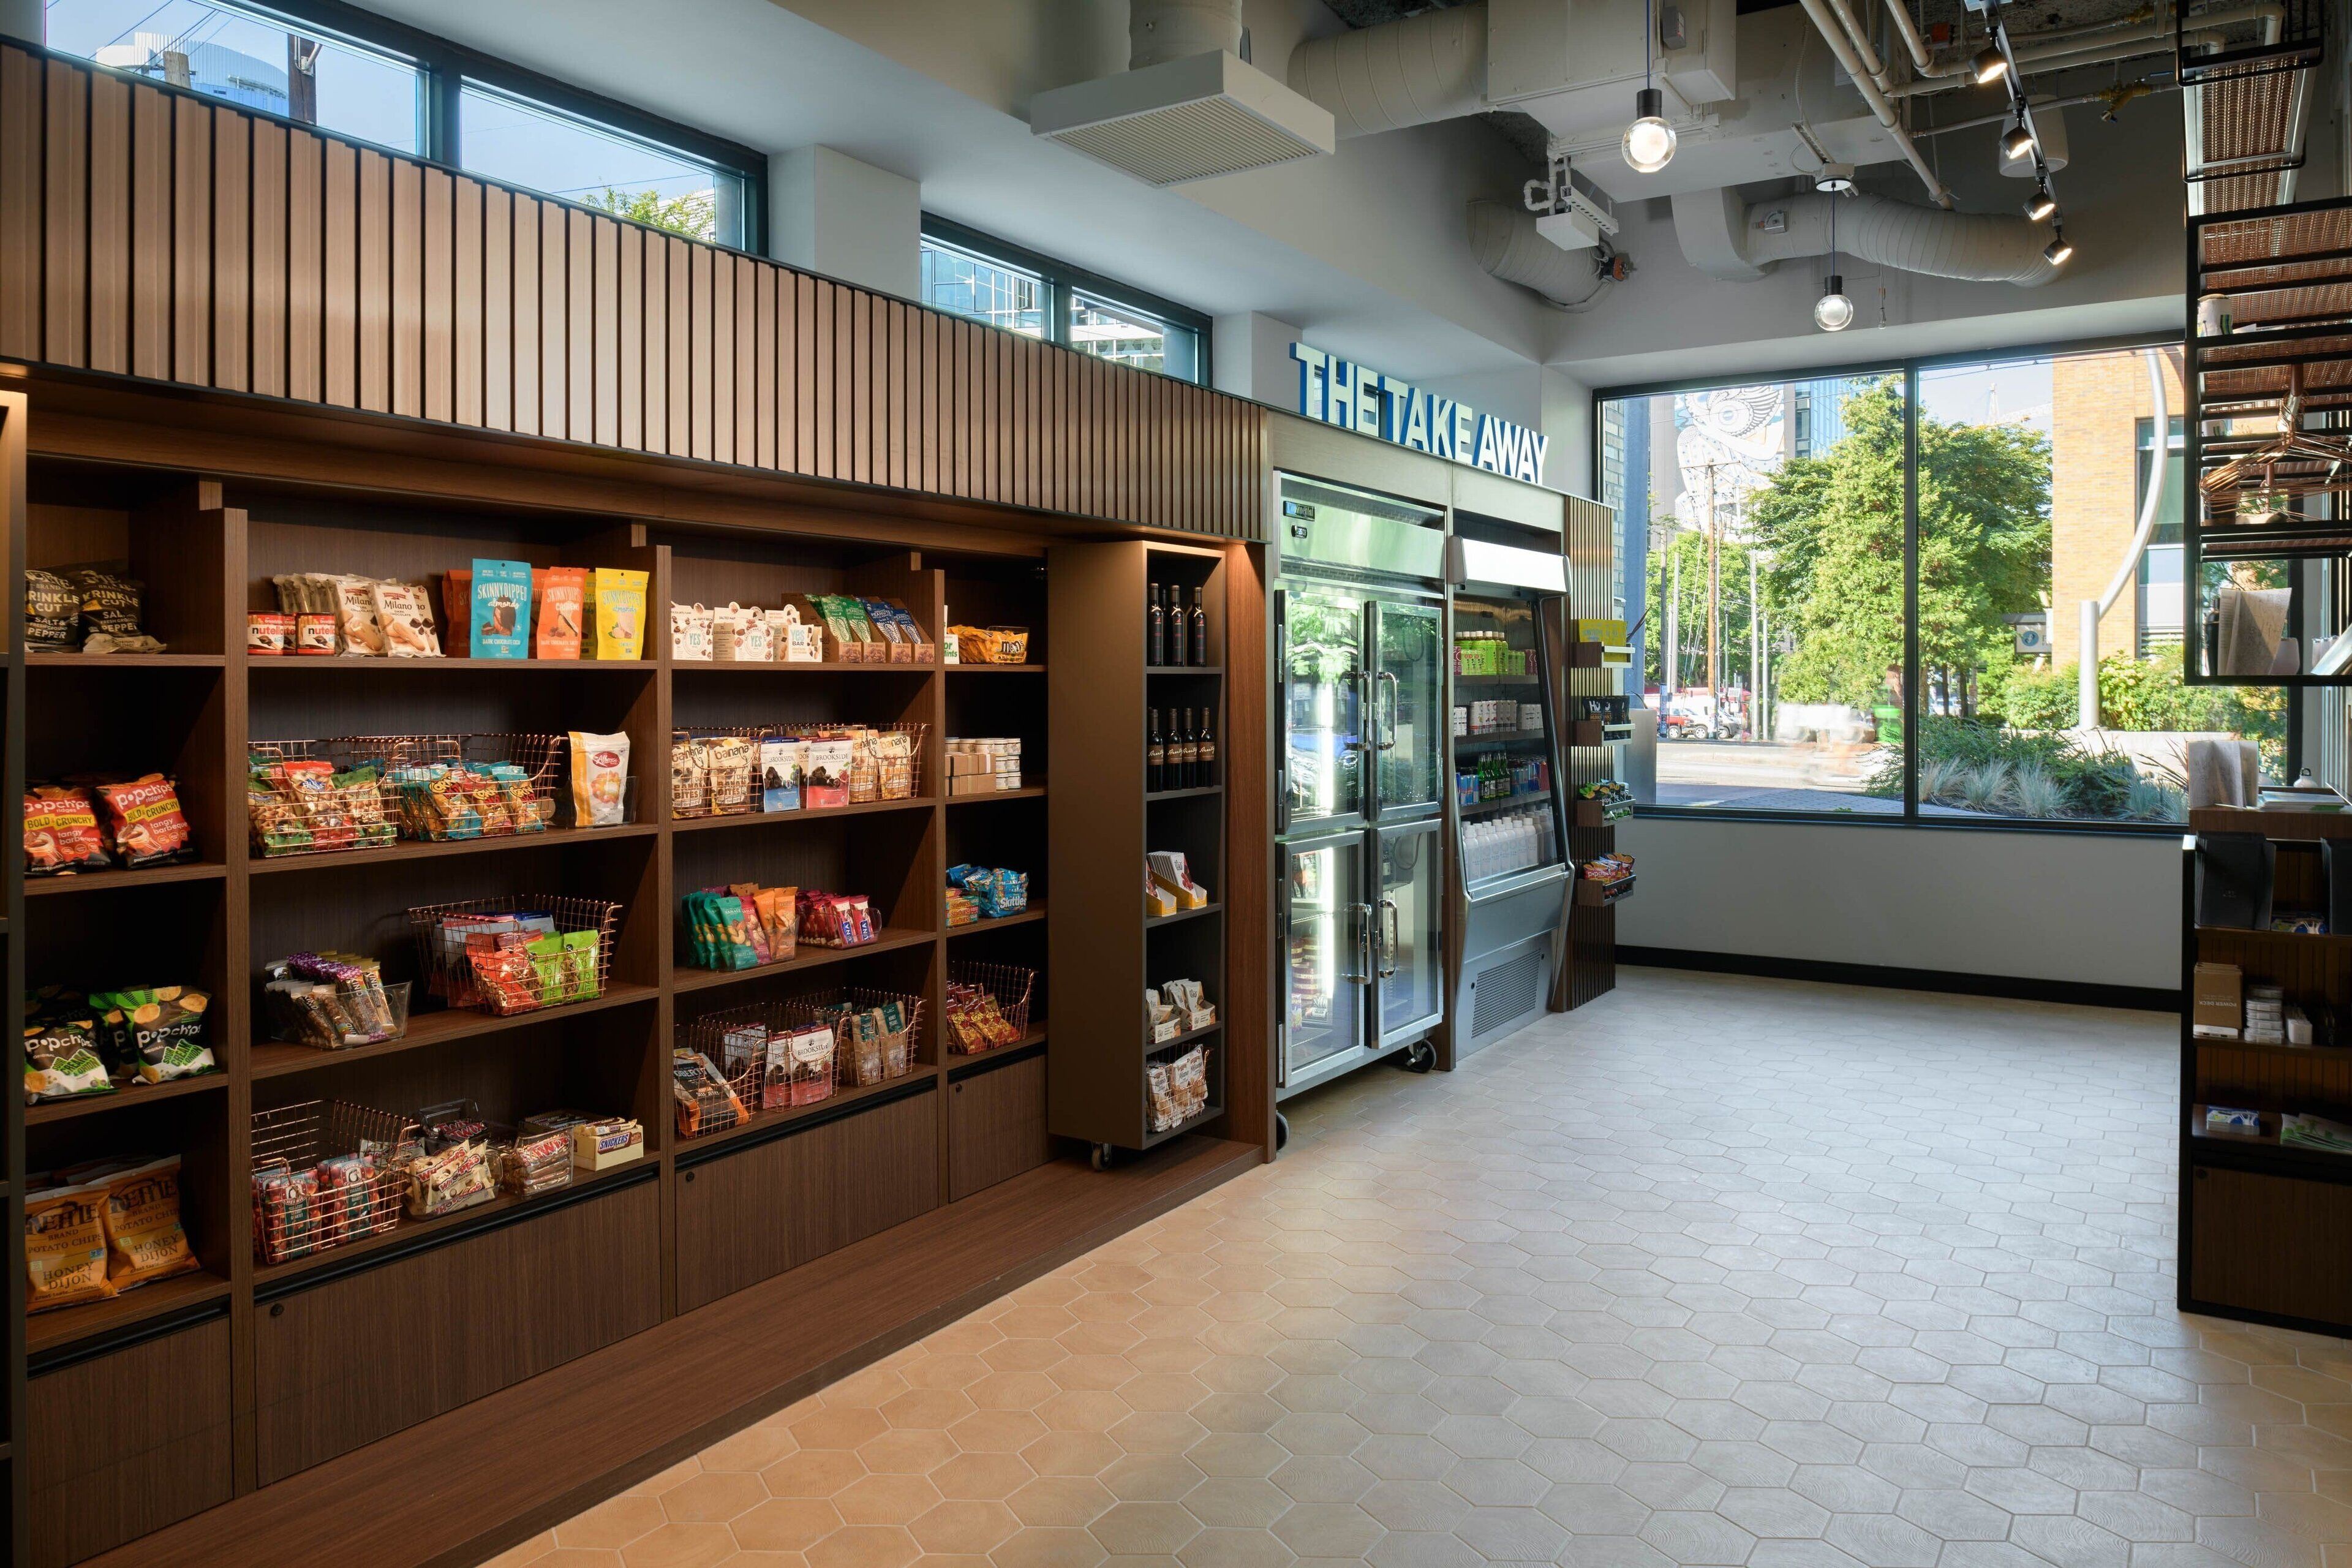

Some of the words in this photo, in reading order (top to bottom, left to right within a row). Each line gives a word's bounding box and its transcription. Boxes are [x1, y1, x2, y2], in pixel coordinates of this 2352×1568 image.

[1289, 342, 1379, 437] THE
[1378, 376, 1472, 466] TAKE
[1472, 413, 1549, 486] AWAY
[26, 590, 80, 605] RINKLE
[81, 590, 138, 607] KRINKLE
[478, 582, 527, 601] SKINNYDIPPED
[547, 586, 582, 602] SKINNYDIP
[36, 603, 61, 612] CUT
[384, 600, 412, 610] Milano
[35, 617, 58, 626] SALT
[104, 610, 126, 619] SAL
[28, 627, 66, 639] PEPPER
[690, 633, 701, 646] YES
[751, 635, 762, 647] YES
[116, 783, 172, 809] popchips
[146, 794, 164, 803] ridges
[127, 809, 142, 821] BOLD
[146, 801, 178, 818] CRUNCHY
[28, 817, 50, 829] BOLD
[56, 816, 92, 827] CRUNCHY
[150, 818, 173, 829] tangy
[153, 821, 187, 834] barbeque
[58, 829, 83, 839] tangy
[59, 836, 98, 845] barbeque
[1000, 896, 1027, 908] Skittles
[350, 977, 363, 997] KIND
[368, 971, 379, 989] KIND
[305, 995, 318, 1010] KIND
[24, 1035, 92, 1052] popchips
[137, 1024, 201, 1048] popchips
[163, 1048, 176, 1065] SOUR
[171, 1041, 193, 1067] CREAM
[186, 1048, 202, 1065] ONION
[797, 1044, 828, 1056] BROOKSIDE
[52, 1057, 67, 1071] SOUR
[61, 1050, 90, 1076] CREAM
[445, 1122, 486, 1139] TWIX
[528, 1135, 569, 1159] TWIX
[600, 1134, 628, 1150] SNICKERS
[132, 1204, 161, 1216] BRAND
[115, 1216, 152, 1232] POTATO
[48, 1229, 78, 1241] BRAND
[28, 1240, 69, 1253] POTATO
[72, 1234, 103, 1246] CHIPS
[134, 1234, 178, 1253] HONEY
[141, 1245, 178, 1262] DIJON
[43, 1262, 93, 1281] HONEY
[49, 1273, 91, 1290] DIJON
